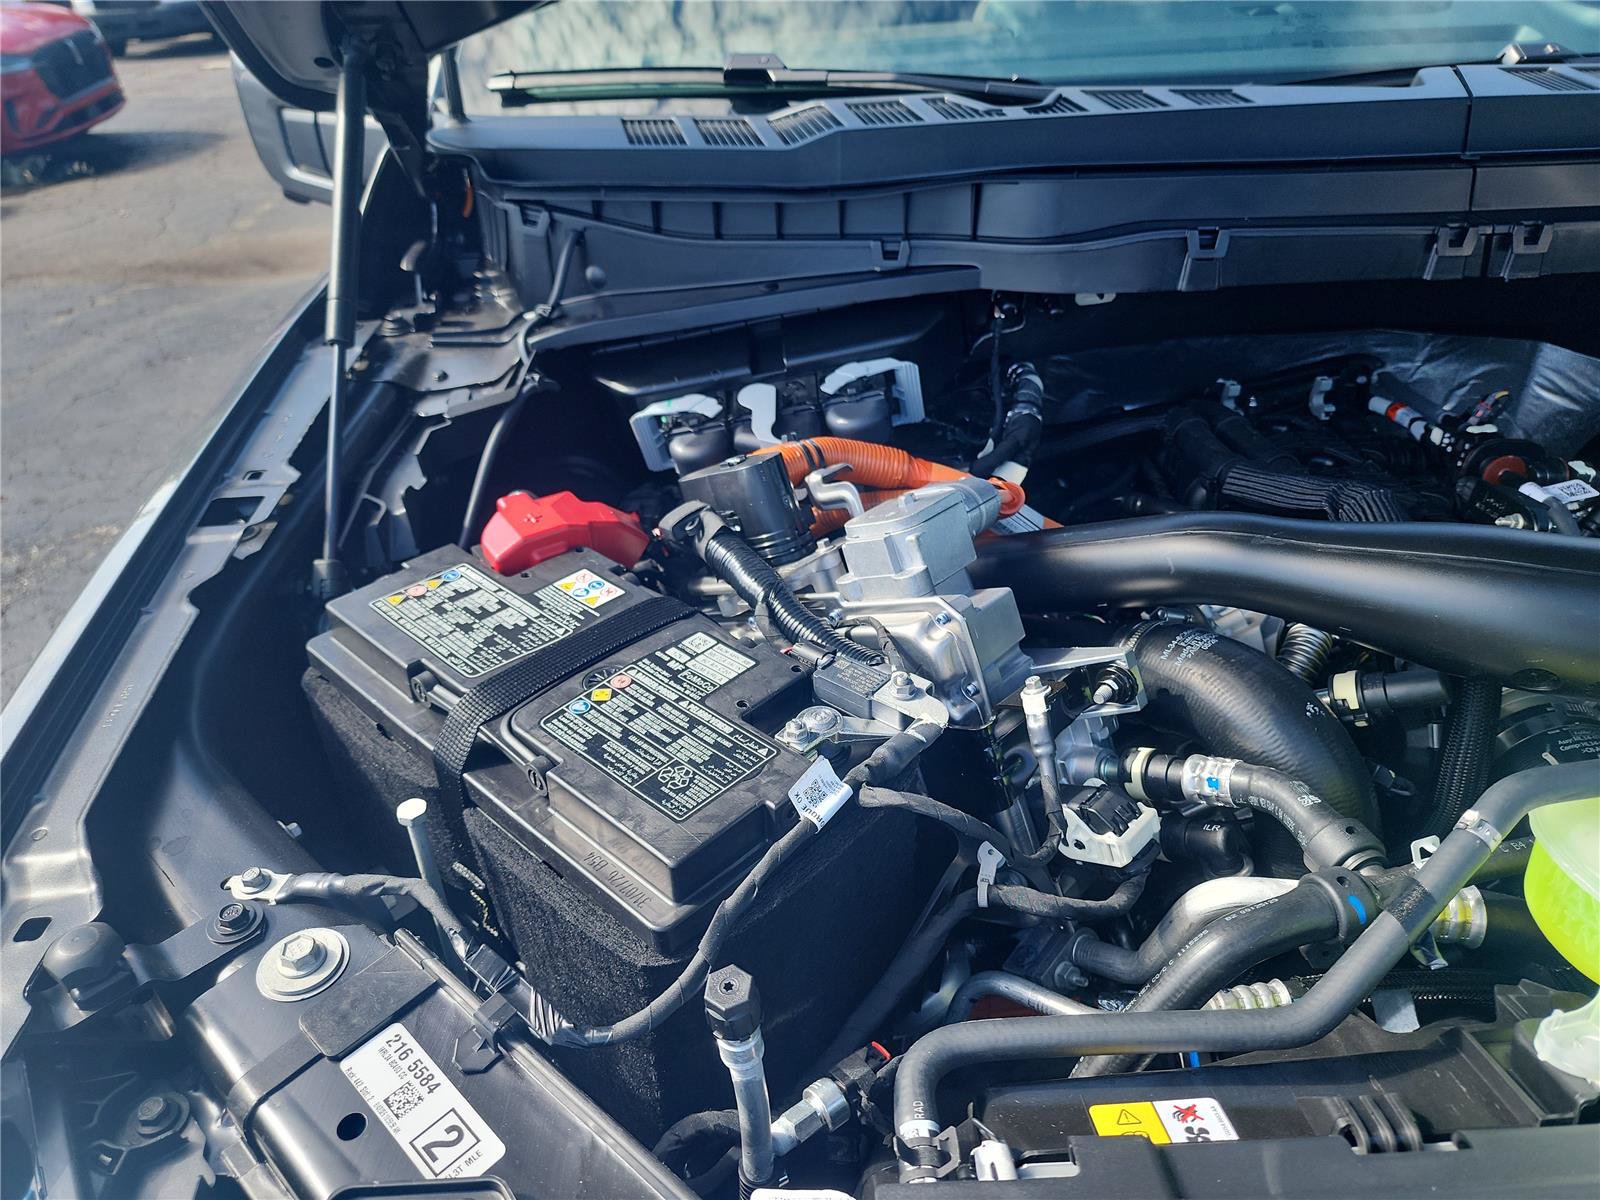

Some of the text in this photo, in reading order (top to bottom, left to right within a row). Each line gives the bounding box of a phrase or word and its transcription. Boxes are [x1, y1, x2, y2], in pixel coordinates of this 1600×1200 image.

[681, 670, 714, 691] FoMoCo
[794, 791, 803, 804] OK
[385, 1033, 442, 1095] 216 5584
[912, 1100, 925, 1120] RAD
[421, 1124, 465, 1164] 2
[465, 1150, 484, 1167] MLE
